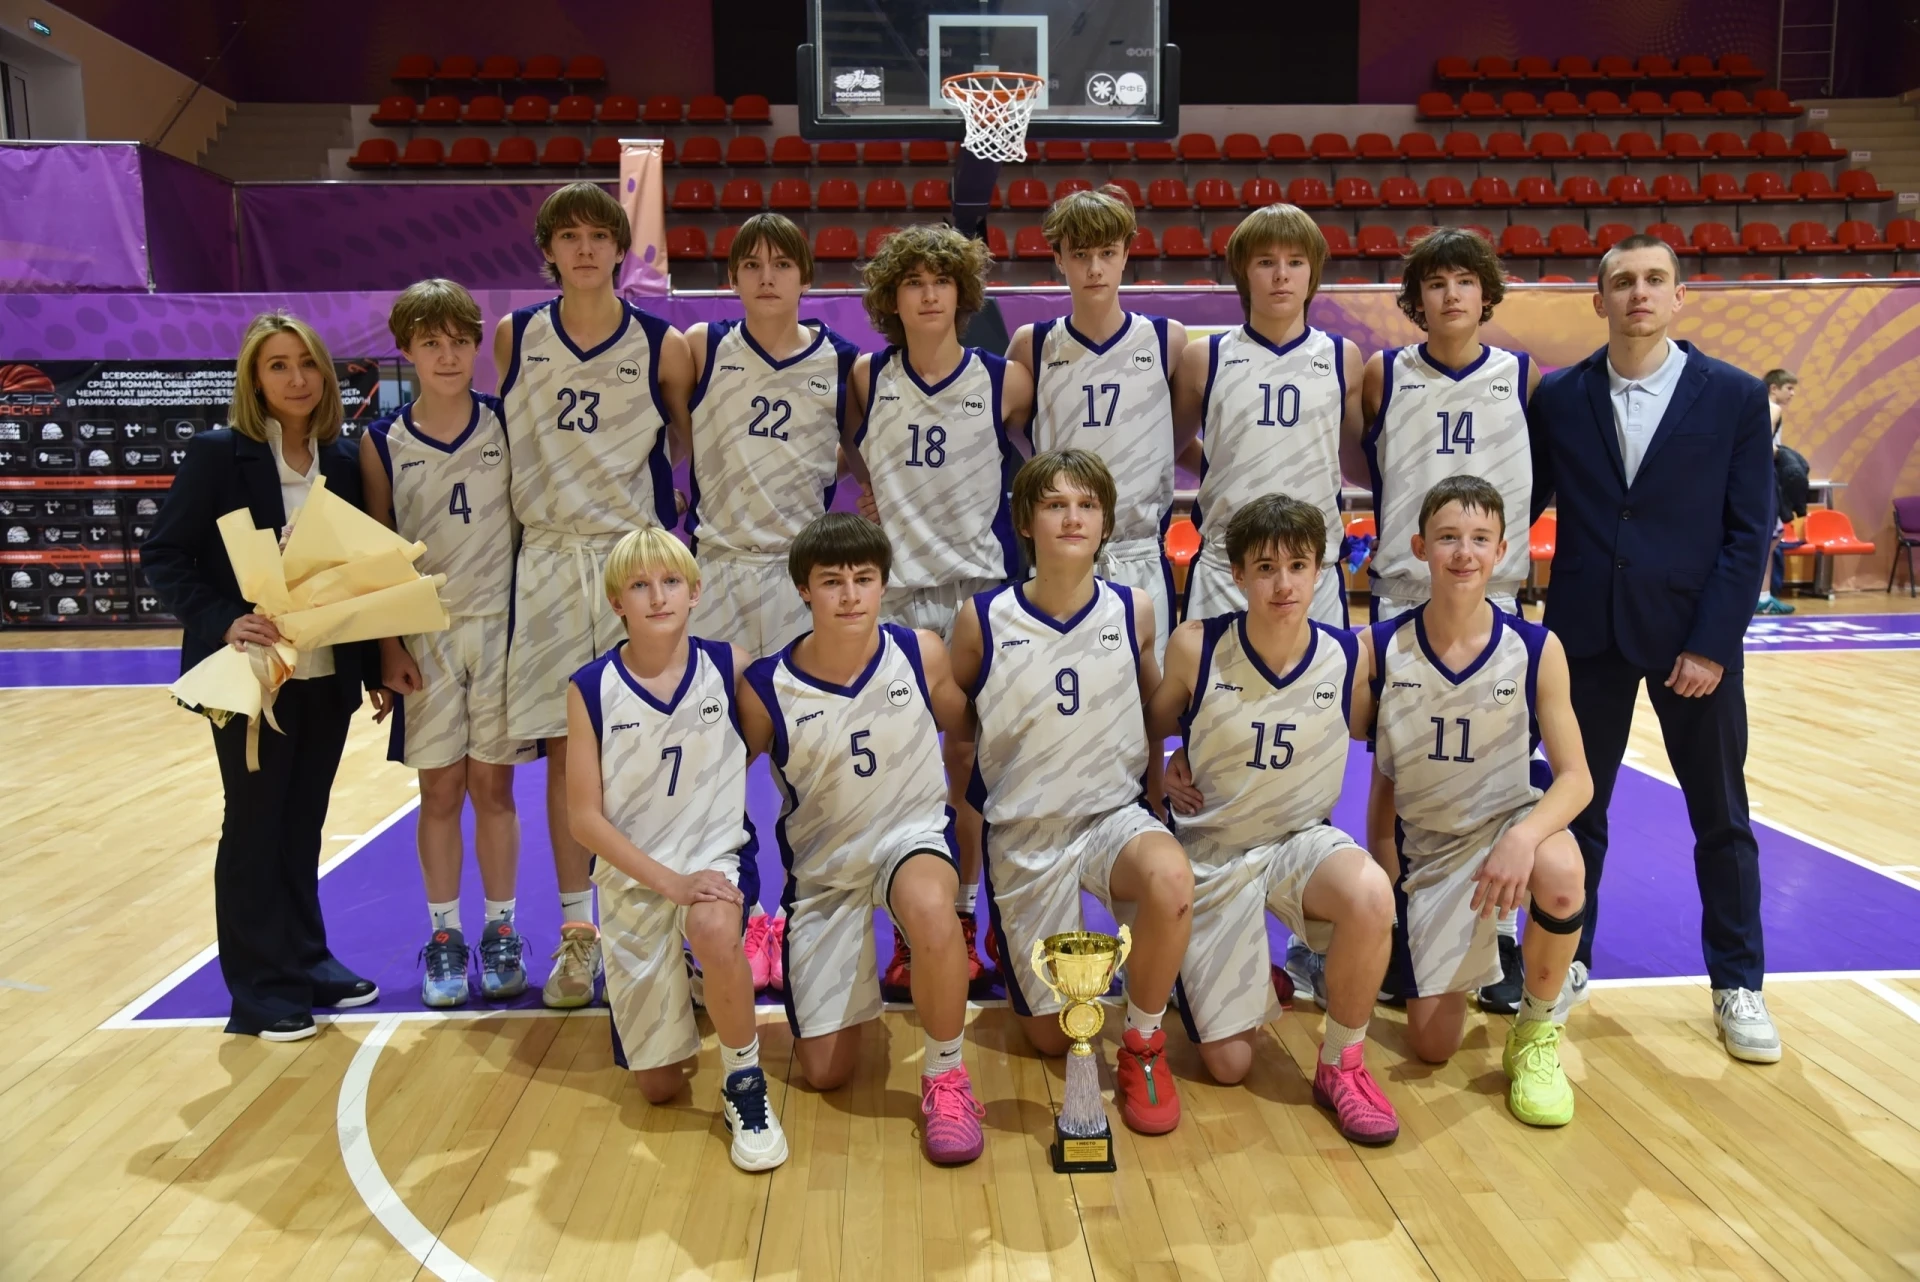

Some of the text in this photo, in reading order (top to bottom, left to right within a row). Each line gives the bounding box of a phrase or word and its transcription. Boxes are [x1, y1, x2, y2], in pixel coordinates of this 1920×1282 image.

[835, 90, 881, 98] РОССИЙСКИЙ
[1119, 85, 1144, 93] РФБ
[1313, 361, 1330, 370] РФБ
[101, 370, 184, 380] ВСЕРОССИЙСКИЕ
[619, 367, 638, 376] РФБ
[87, 380, 119, 389] СРЕДИ
[120, 380, 163, 389] КОМАНД
[810, 380, 828, 390] РФБ
[1492, 385, 1509, 393] РФБ
[76, 389, 135, 397] ЧЕМПИОНАТ
[137, 387, 191, 397] ШКОЛЬНОЙ
[78, 398, 116, 406] РАМКАХ
[117, 396, 213, 407] ОБЩЕРОССИЙСКОГО
[965, 401, 983, 409] РФБ
[1082, 383, 1120, 427] 17
[1257, 383, 1300, 427] 10
[557, 387, 600, 433] 23
[748, 395, 792, 441] 22
[1436, 411, 1475, 454] 14
[905, 424, 946, 468] 18
[483, 450, 500, 458] РФБ
[449, 482, 472, 524] 4
[1102, 633, 1119, 642] РФБ
[890, 687, 909, 698] РФБ
[1055, 668, 1079, 716] 9
[1316, 691, 1335, 700] РФБ
[1428, 716, 1475, 763] 11
[1245, 721, 1297, 770] 15
[850, 729, 877, 778] 5
[661, 745, 682, 797] 7
